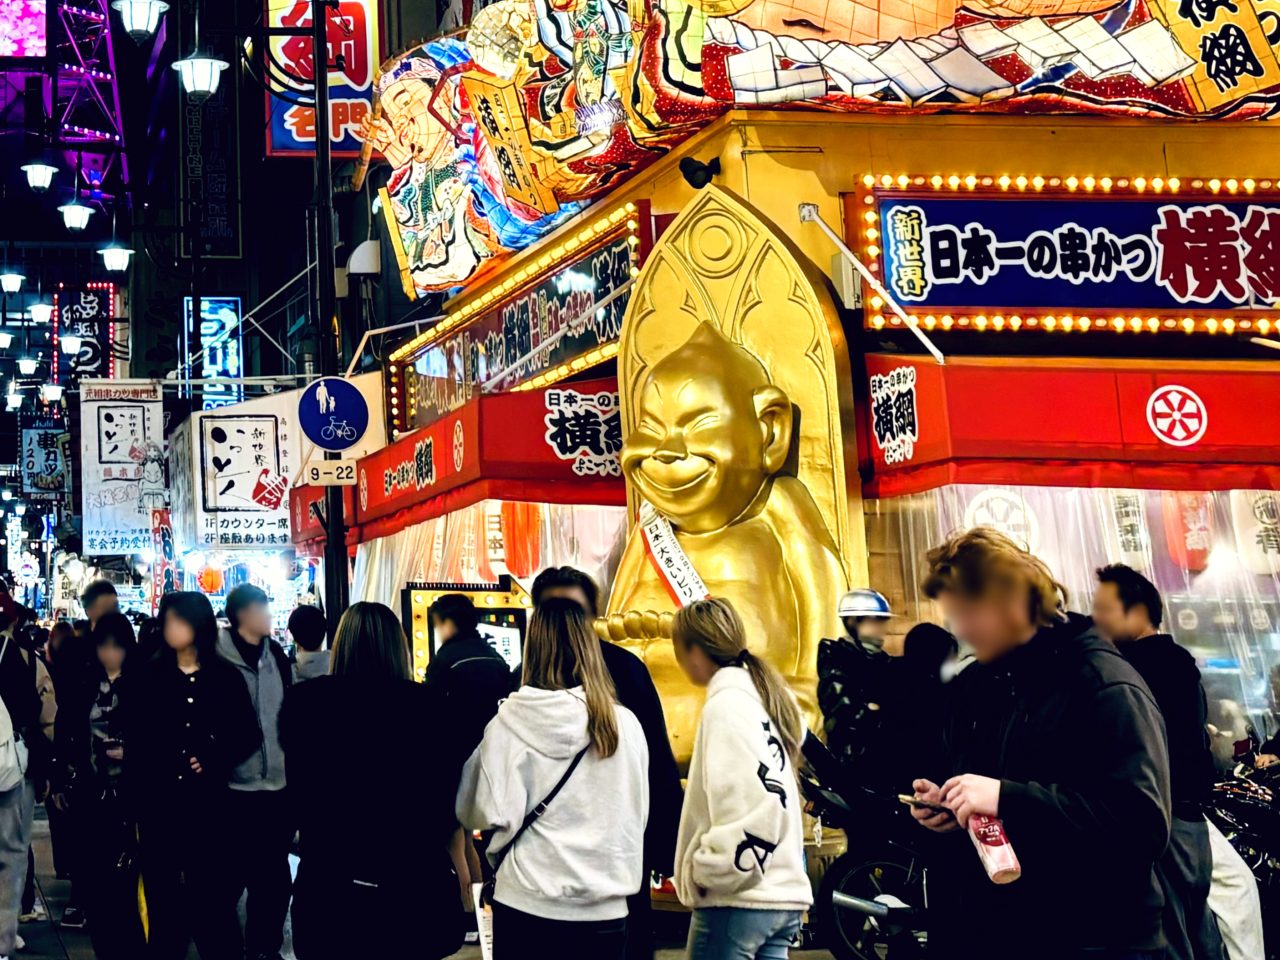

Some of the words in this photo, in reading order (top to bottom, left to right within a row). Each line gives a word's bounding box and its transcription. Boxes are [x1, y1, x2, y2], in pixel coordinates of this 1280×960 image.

[894, 210, 926, 297] 新世界
[930, 227, 1152, 280] 日本一の串かつ
[874, 388, 916, 444] 横綱
[220, 518, 288, 530] カウンター席
